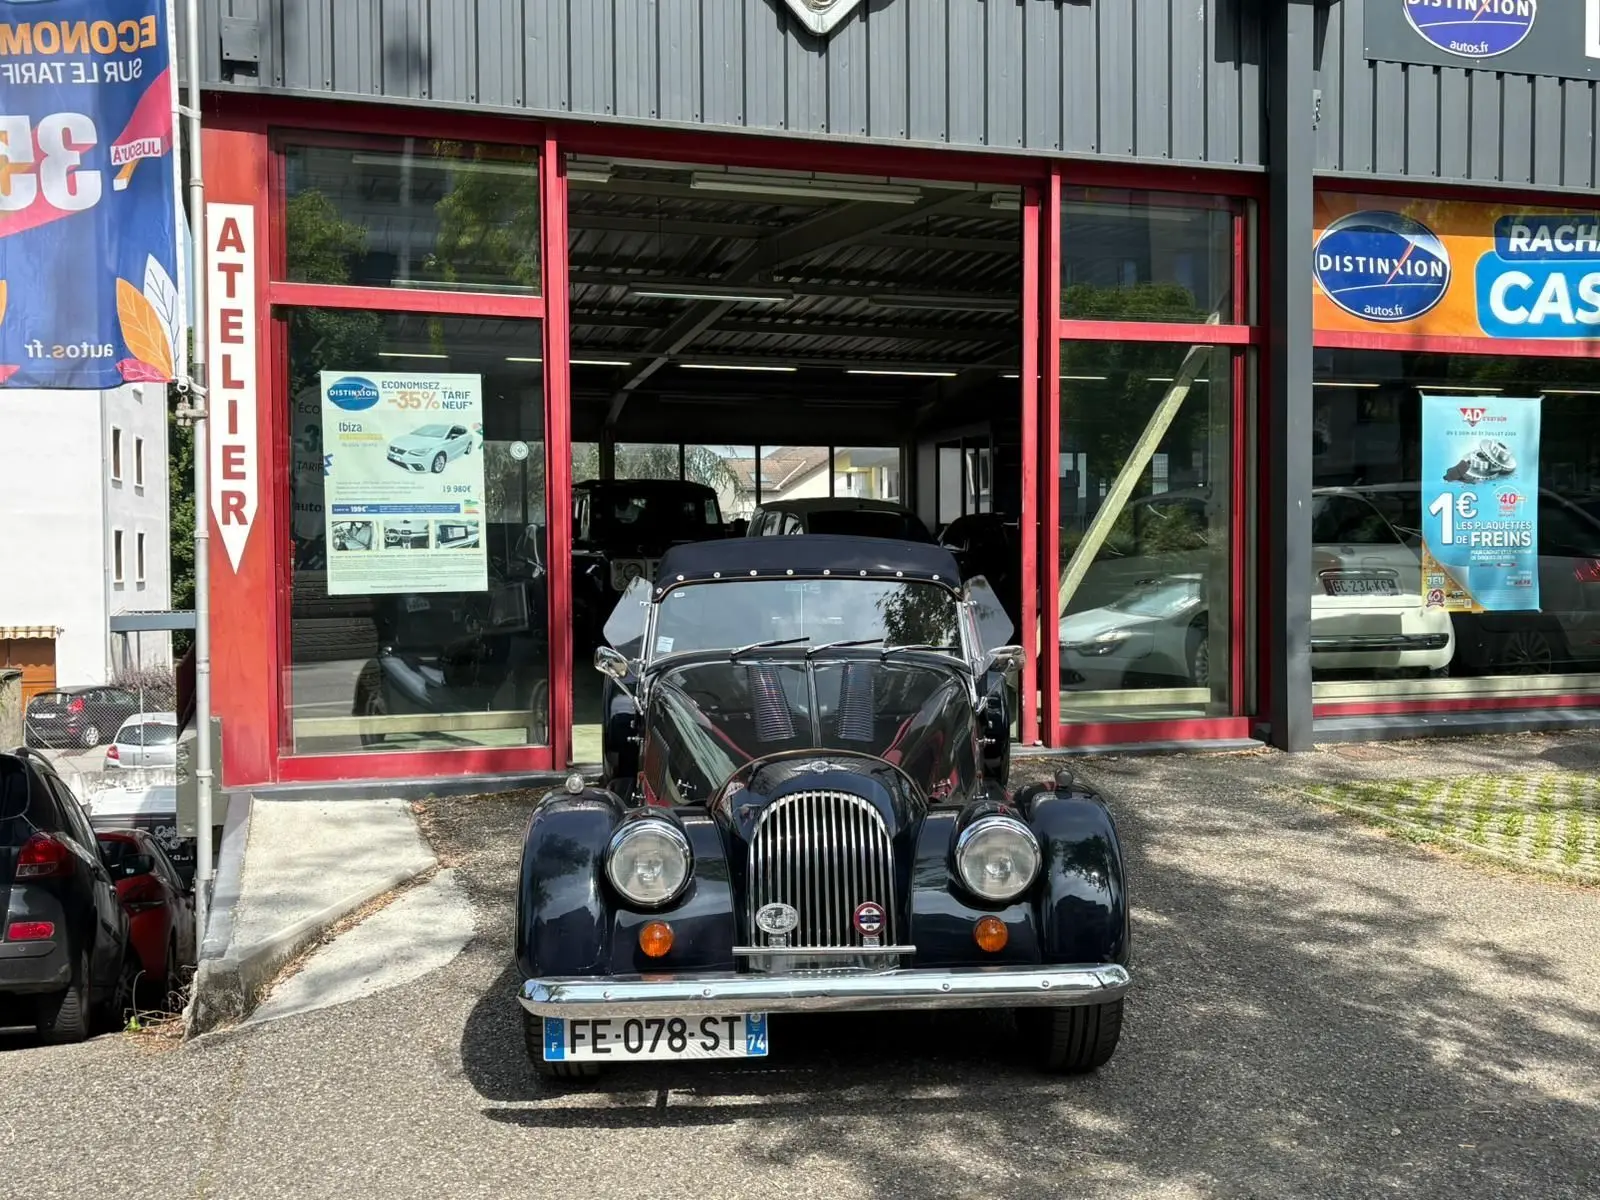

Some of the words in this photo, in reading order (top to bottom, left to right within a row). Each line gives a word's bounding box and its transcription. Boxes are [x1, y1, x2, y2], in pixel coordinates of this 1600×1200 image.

[1450, 41, 1489, 53] autos.fr
[1508, 224, 1600, 252] RACH
[1319, 254, 1443, 278] DISTINXION
[1364, 304, 1404, 317] autos.fr
[216, 216, 249, 526] ATELIER
[381, 380, 440, 390] ECONOMISEZ
[329, 389, 378, 398] DISTINXION
[442, 391, 471, 400] TARIF
[388, 391, 440, 410] -35%
[1464, 409, 1482, 421] AD
[338, 421, 362, 433] Ibiza
[1456, 520, 1473, 530] LES
[1475, 520, 1531, 530] PLAQUETTES
[1456, 535, 1468, 544] DE
[1470, 531, 1531, 547] FREINS
[570, 1016, 742, 1054] FE-078-ST
[551, 1041, 558, 1052] F
[747, 1034, 765, 1051] 74
